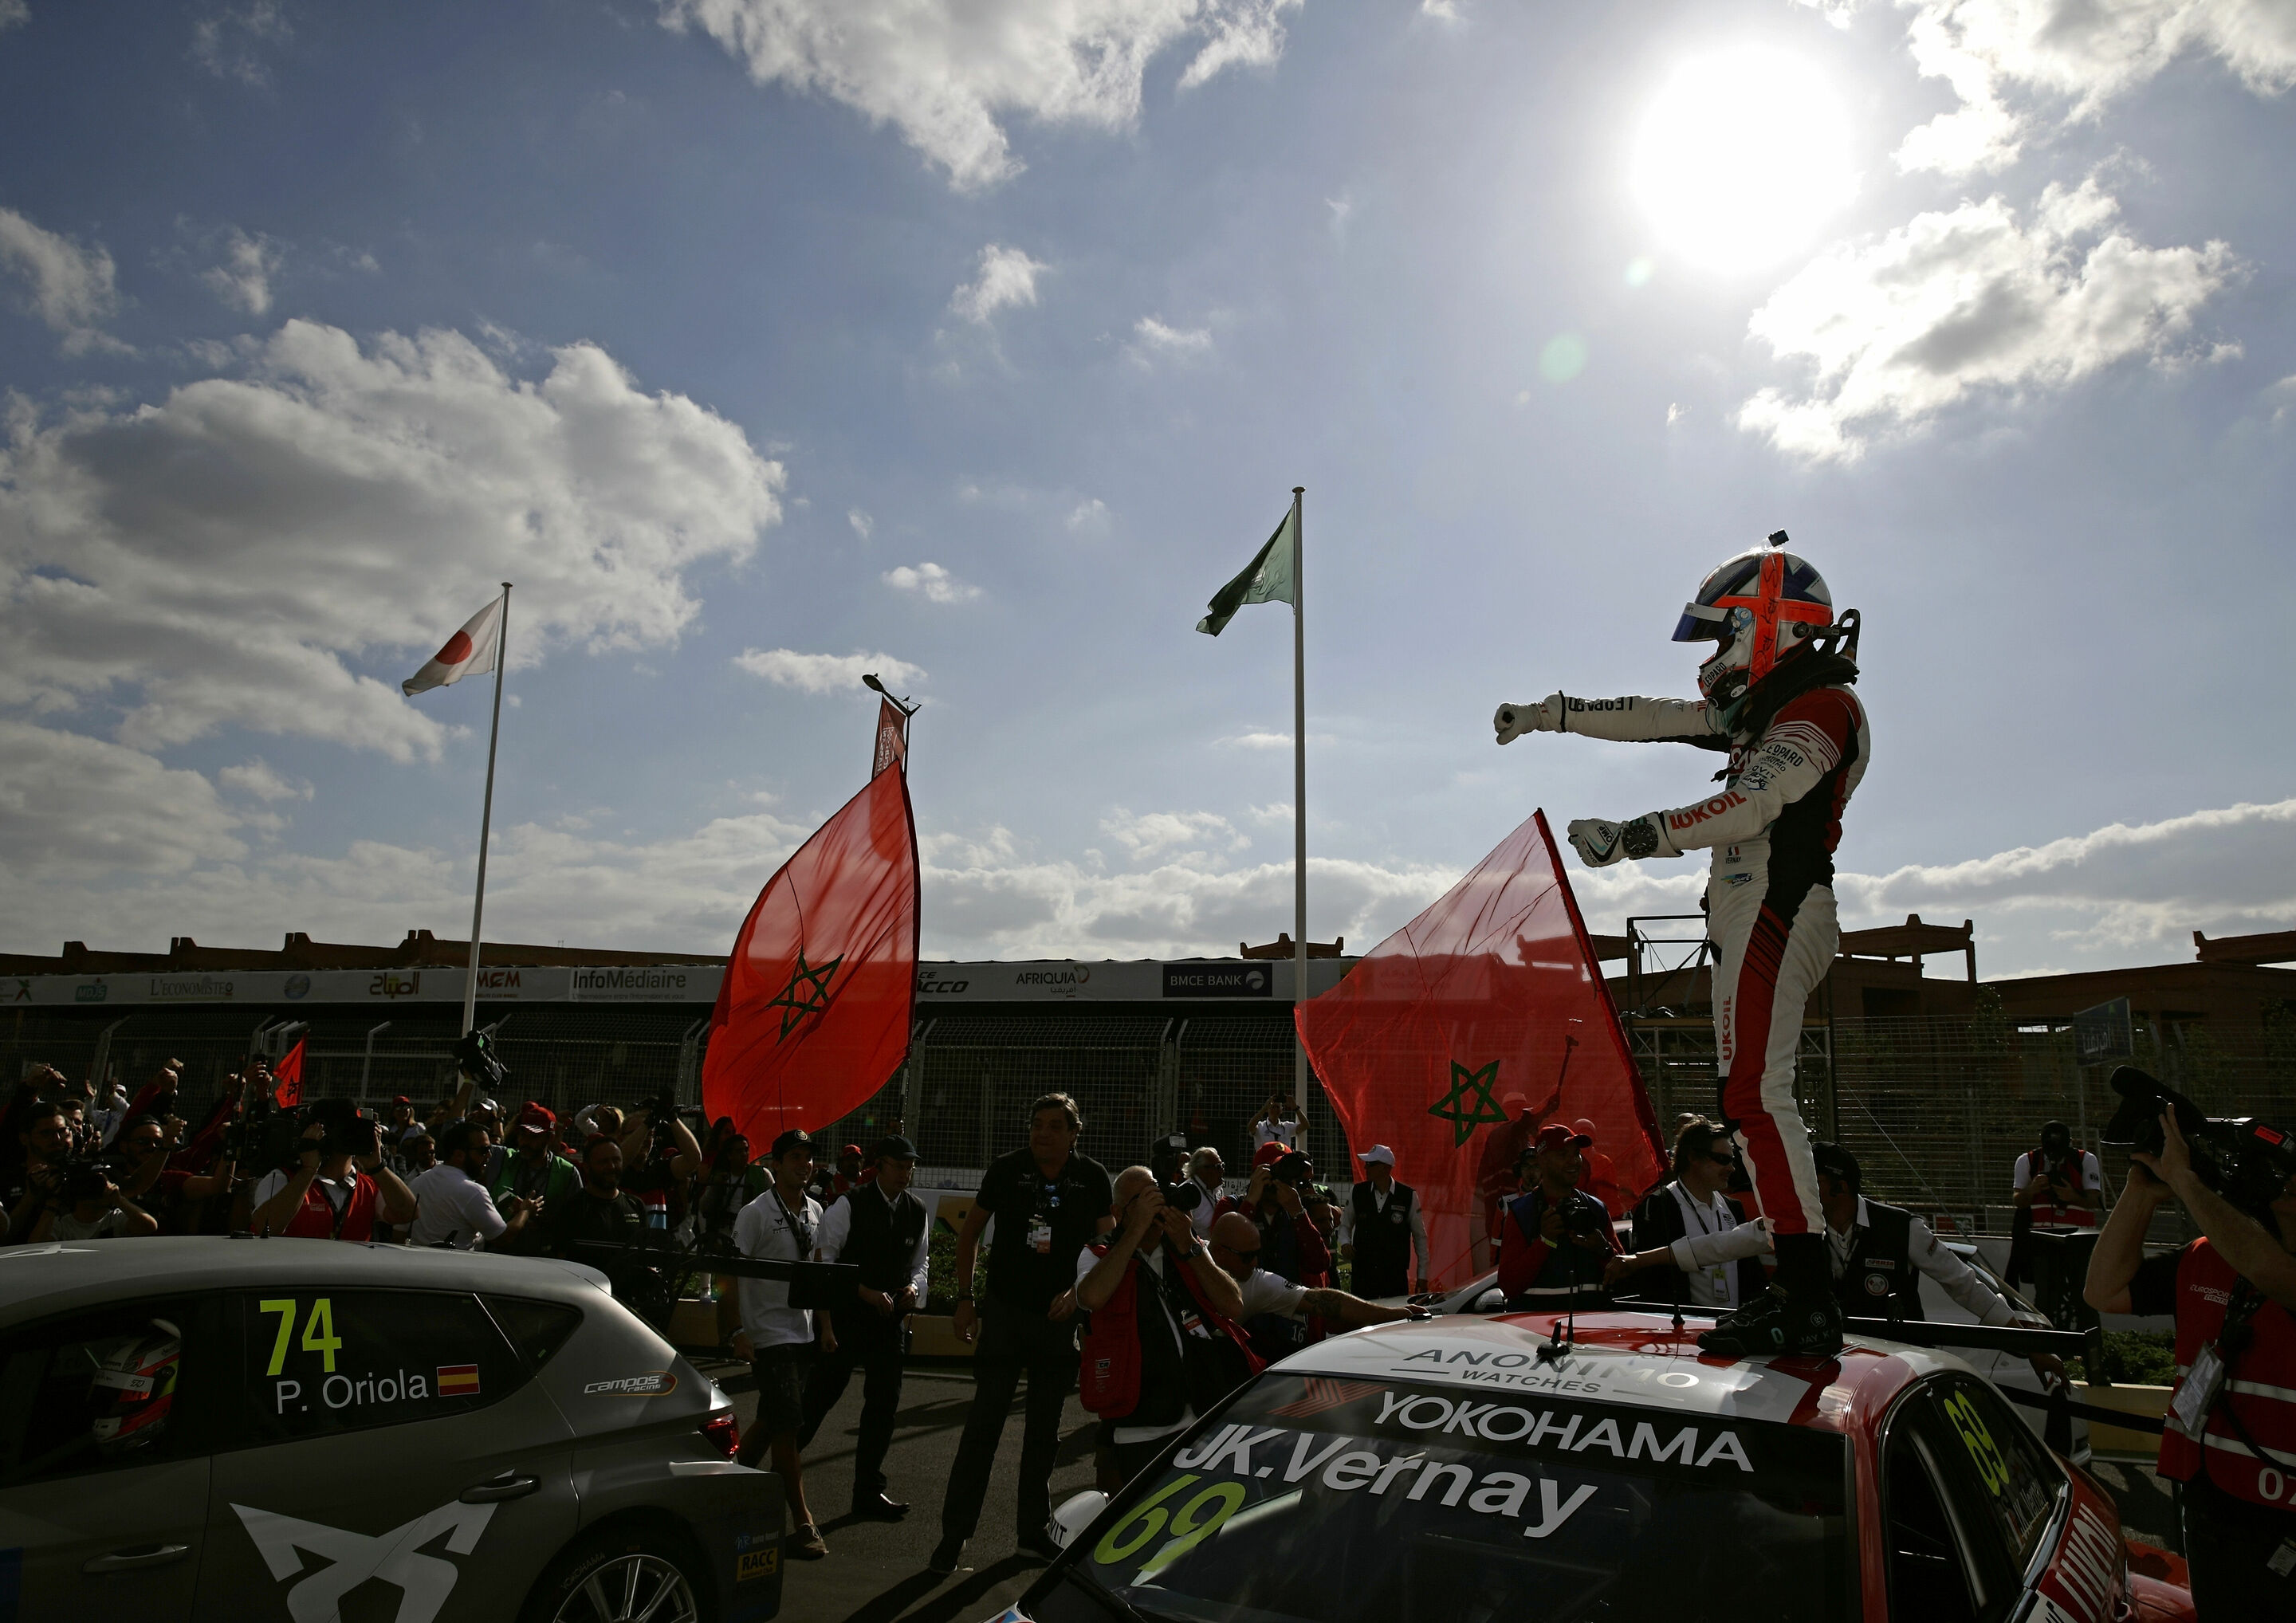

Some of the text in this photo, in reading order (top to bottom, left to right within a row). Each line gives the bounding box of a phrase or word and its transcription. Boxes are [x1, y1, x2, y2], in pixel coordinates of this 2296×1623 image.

[1704, 662, 1727, 686] LEOPARD
[1669, 791, 1748, 830] LUKOIL
[1598, 826, 1613, 843] OMP
[150, 979, 226, 996] L'ECONOMISTE
[573, 970, 686, 988] InfoMédiaire
[1016, 973, 1076, 984] AFRIQUIA
[1170, 975, 1242, 986] BMCE BANK
[2189, 1284, 2231, 1299] EUROSPOR
[259, 1297, 342, 1377] 74
[1404, 1349, 1700, 1388] ANONIMO
[276, 1369, 429, 1414] P. Oriola
[584, 1375, 660, 1393] campos
[1461, 1370, 1602, 1393] WATCHES
[1374, 1390, 1754, 1472] YOKOHAMA
[1944, 1390, 2010, 1497] 69
[1174, 1424, 1598, 1539] JK.Vernay
[1093, 1472, 1247, 1572] 69
[742, 1550, 774, 1571] RACC
